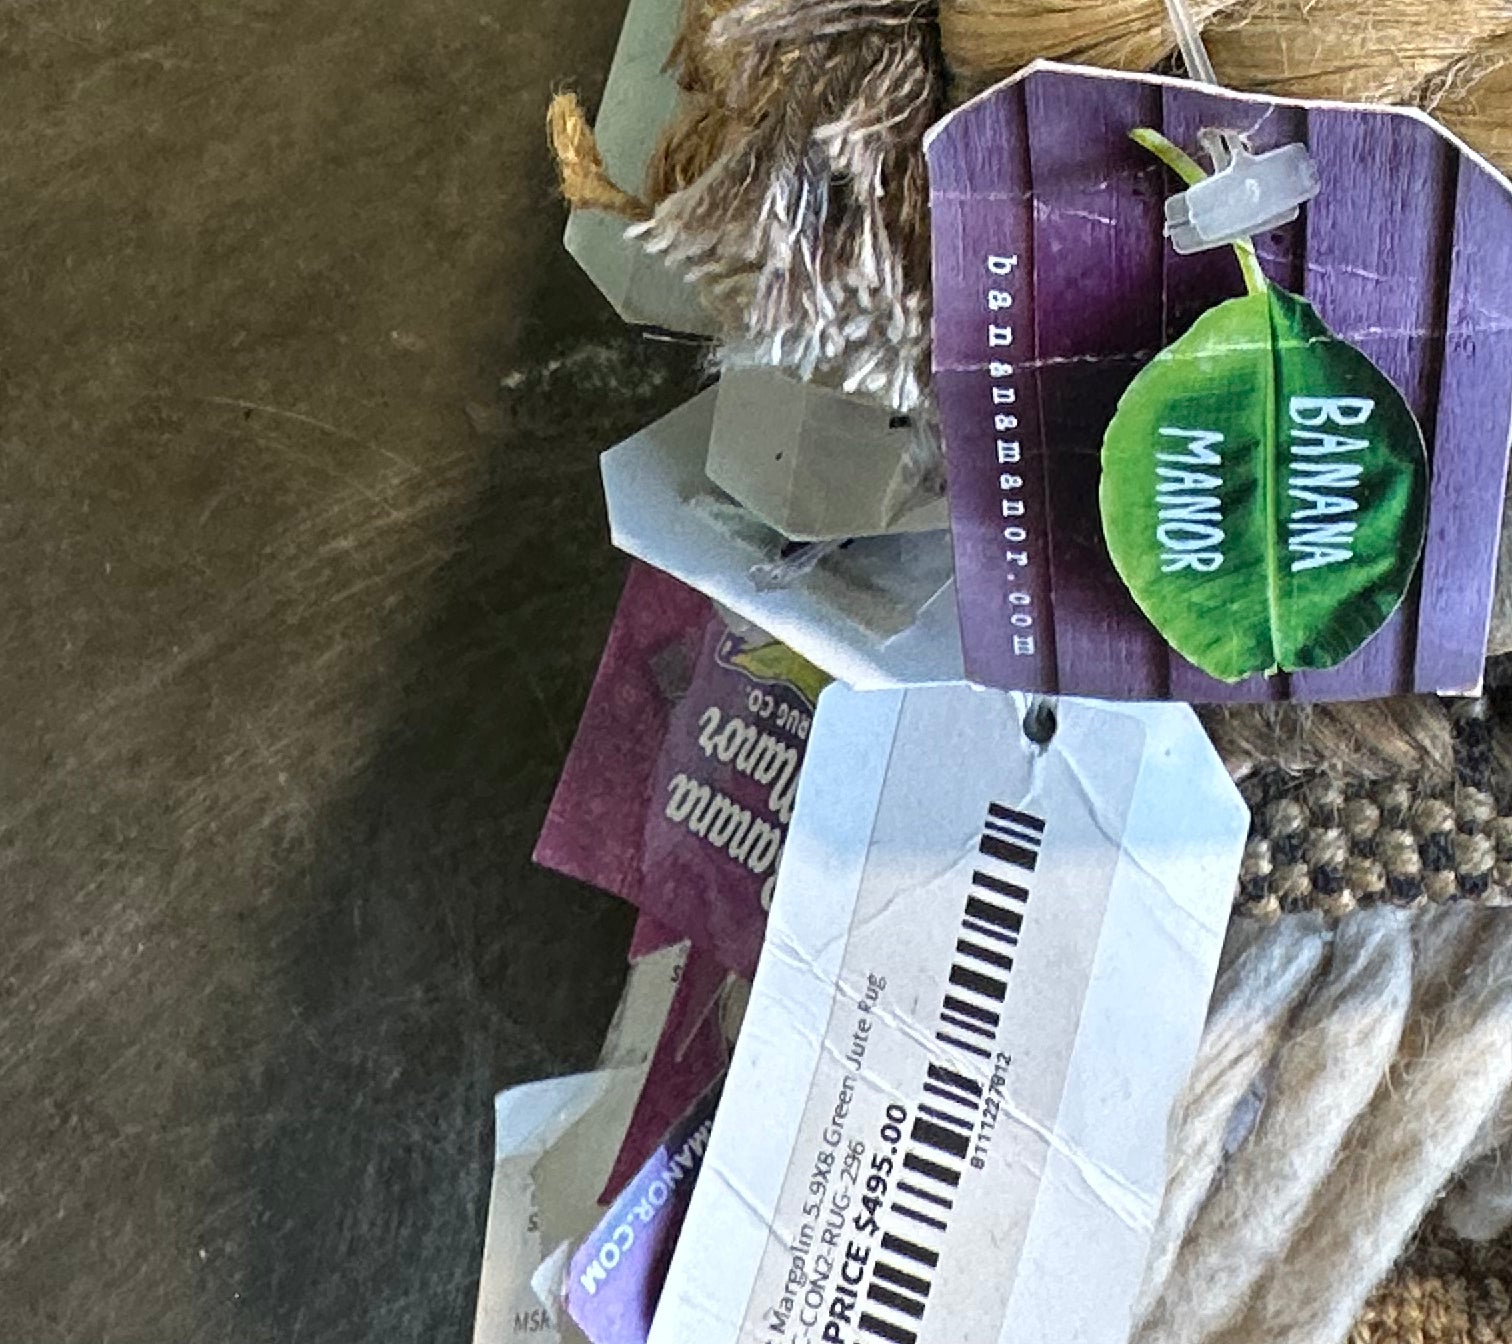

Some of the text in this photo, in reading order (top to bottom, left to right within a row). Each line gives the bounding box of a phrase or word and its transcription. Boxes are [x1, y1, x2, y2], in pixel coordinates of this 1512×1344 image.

[988, 255, 1035, 656] bananamanor.com
[1154, 426, 1225, 573] MANOR
[1288, 395, 1375, 573] BANANA
[778, 702, 813, 741] RUG
[845, 1015, 872, 1071] Jute
[858, 972, 888, 1013] Rug
[823, 1075, 853, 1145] Green
[580, 1119, 713, 1297] MANOR.COM
[821, 1104, 908, 1344] PRICE $495.00
